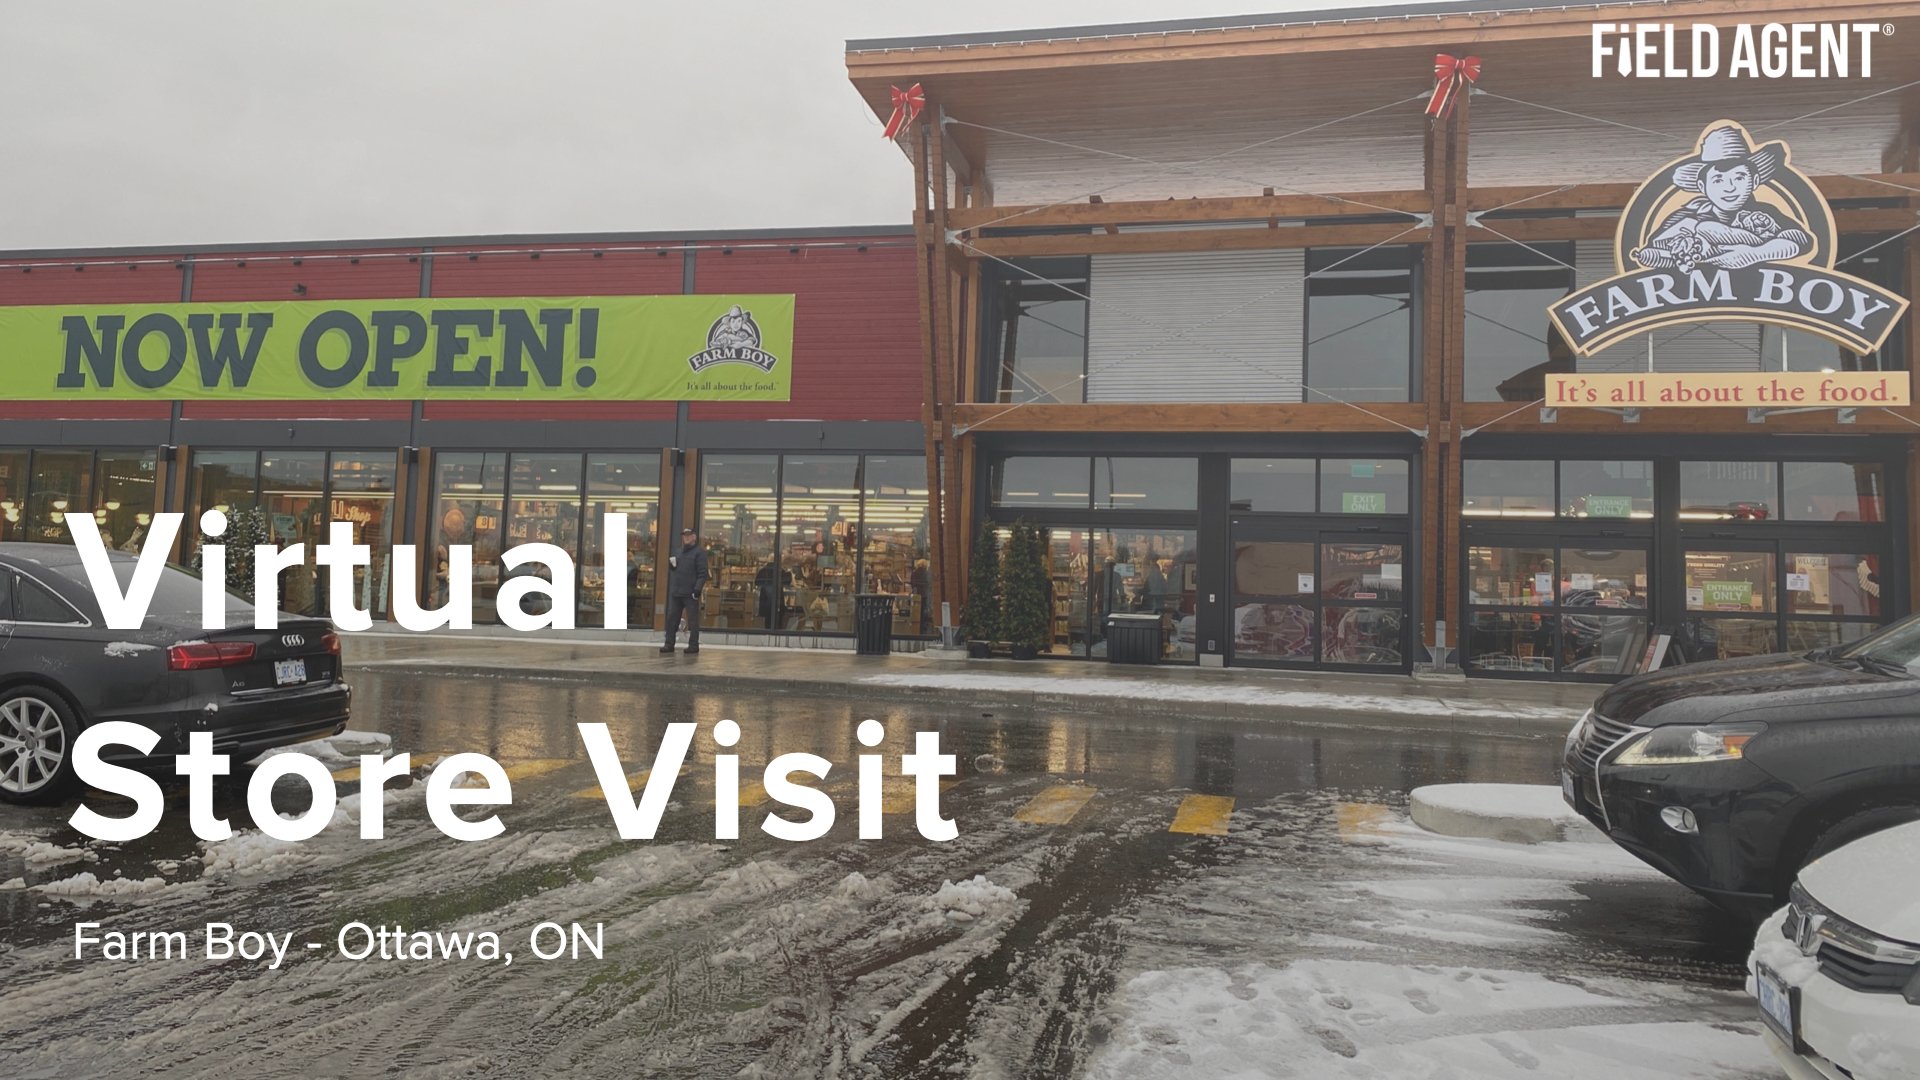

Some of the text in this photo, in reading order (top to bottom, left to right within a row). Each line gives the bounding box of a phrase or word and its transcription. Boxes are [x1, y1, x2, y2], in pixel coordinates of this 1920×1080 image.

[1565, 268, 1890, 338] FARM BOY
[56, 307, 600, 389] NOW OPEN!
[691, 347, 775, 369] FARM BOY
[687, 382, 777, 391] It's all about the food.
[1556, 379, 1899, 403] It's all about the food.
[1352, 495, 1376, 504] EXIT
[1351, 503, 1377, 512] ONLY
[1595, 505, 1625, 515] ONLY
[1706, 584, 1749, 592] ENTRANCE
[1712, 591, 1743, 601] ONLY
